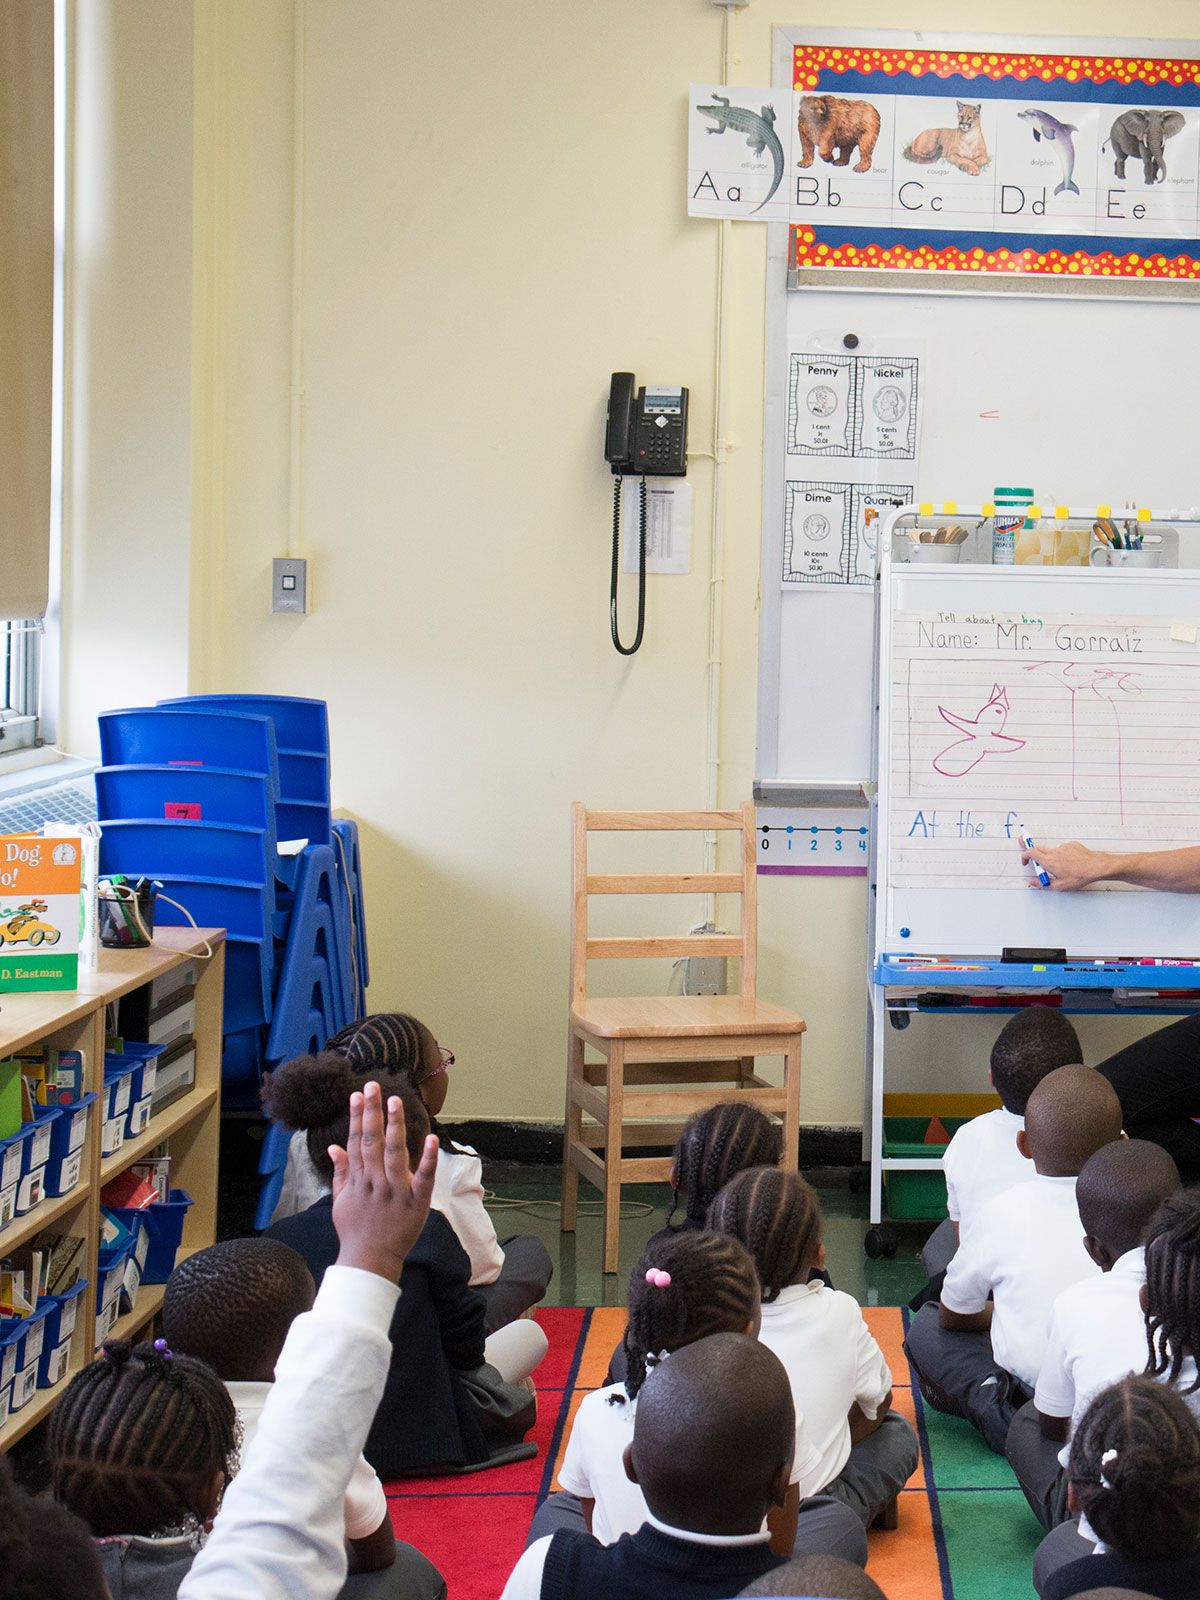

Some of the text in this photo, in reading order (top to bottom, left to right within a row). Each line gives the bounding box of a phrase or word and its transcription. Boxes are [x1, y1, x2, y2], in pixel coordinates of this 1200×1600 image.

[741, 161, 768, 170] alligator
[1030, 158, 1054, 167] dolphin
[872, 166, 888, 174] bear
[1167, 176, 1195, 186] elephant
[692, 171, 741, 203] Aa
[796, 177, 840, 208] Bb
[898, 182, 942, 211] Cc
[1001, 185, 1046, 216] Dd
[1107, 190, 1145, 219] Ee
[808, 364, 840, 377] Penny
[874, 367, 905, 377] Nickel
[805, 492, 833, 502] Dime
[937, 612, 956, 623] Tell
[965, 613, 995, 624] about
[1021, 614, 1043, 631] bug
[918, 621, 1143, 652] Name: Mr. Gorraiz
[908, 811, 939, 838] At
[956, 811, 984, 837] the
[762, 839, 866, 851] 0 1 2 3 4
[5, 843, 43, 867] Dog.
[1, 968, 62, 979] D. Eastman
